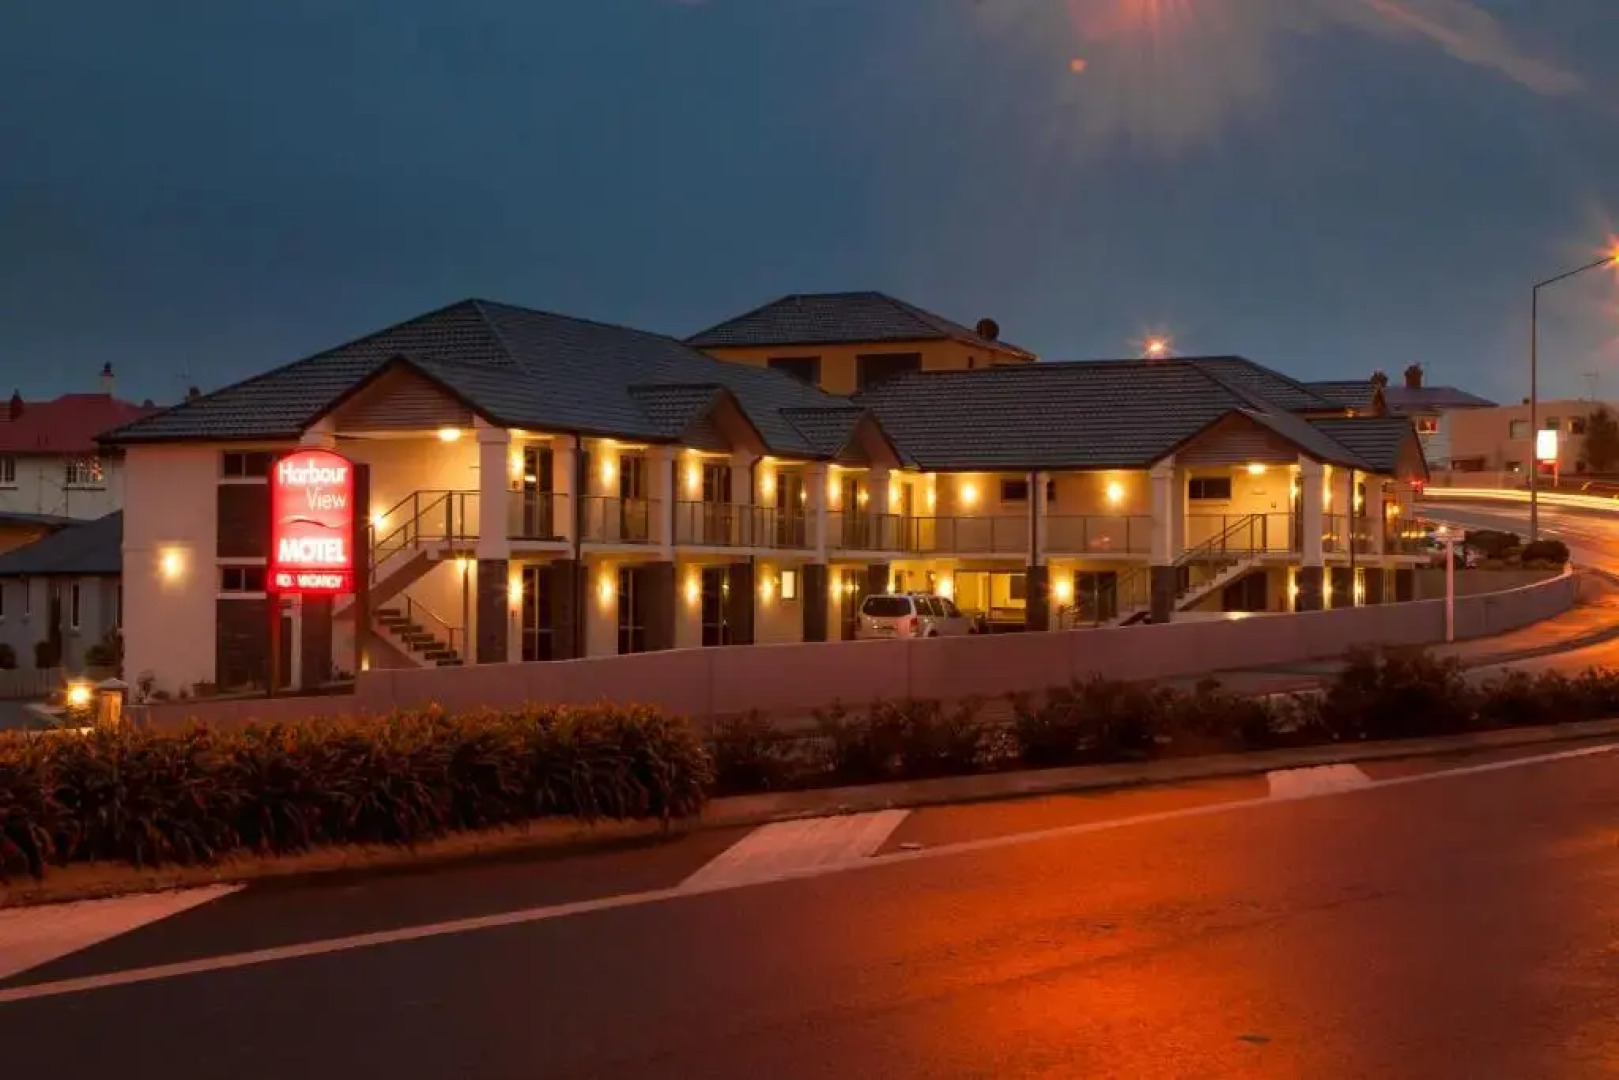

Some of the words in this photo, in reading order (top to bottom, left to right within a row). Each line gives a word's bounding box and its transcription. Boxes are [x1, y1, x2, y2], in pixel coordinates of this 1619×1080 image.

[278, 458, 349, 485] Harbour
[306, 485, 347, 511] View
[278, 538, 346, 563] MOTEL
